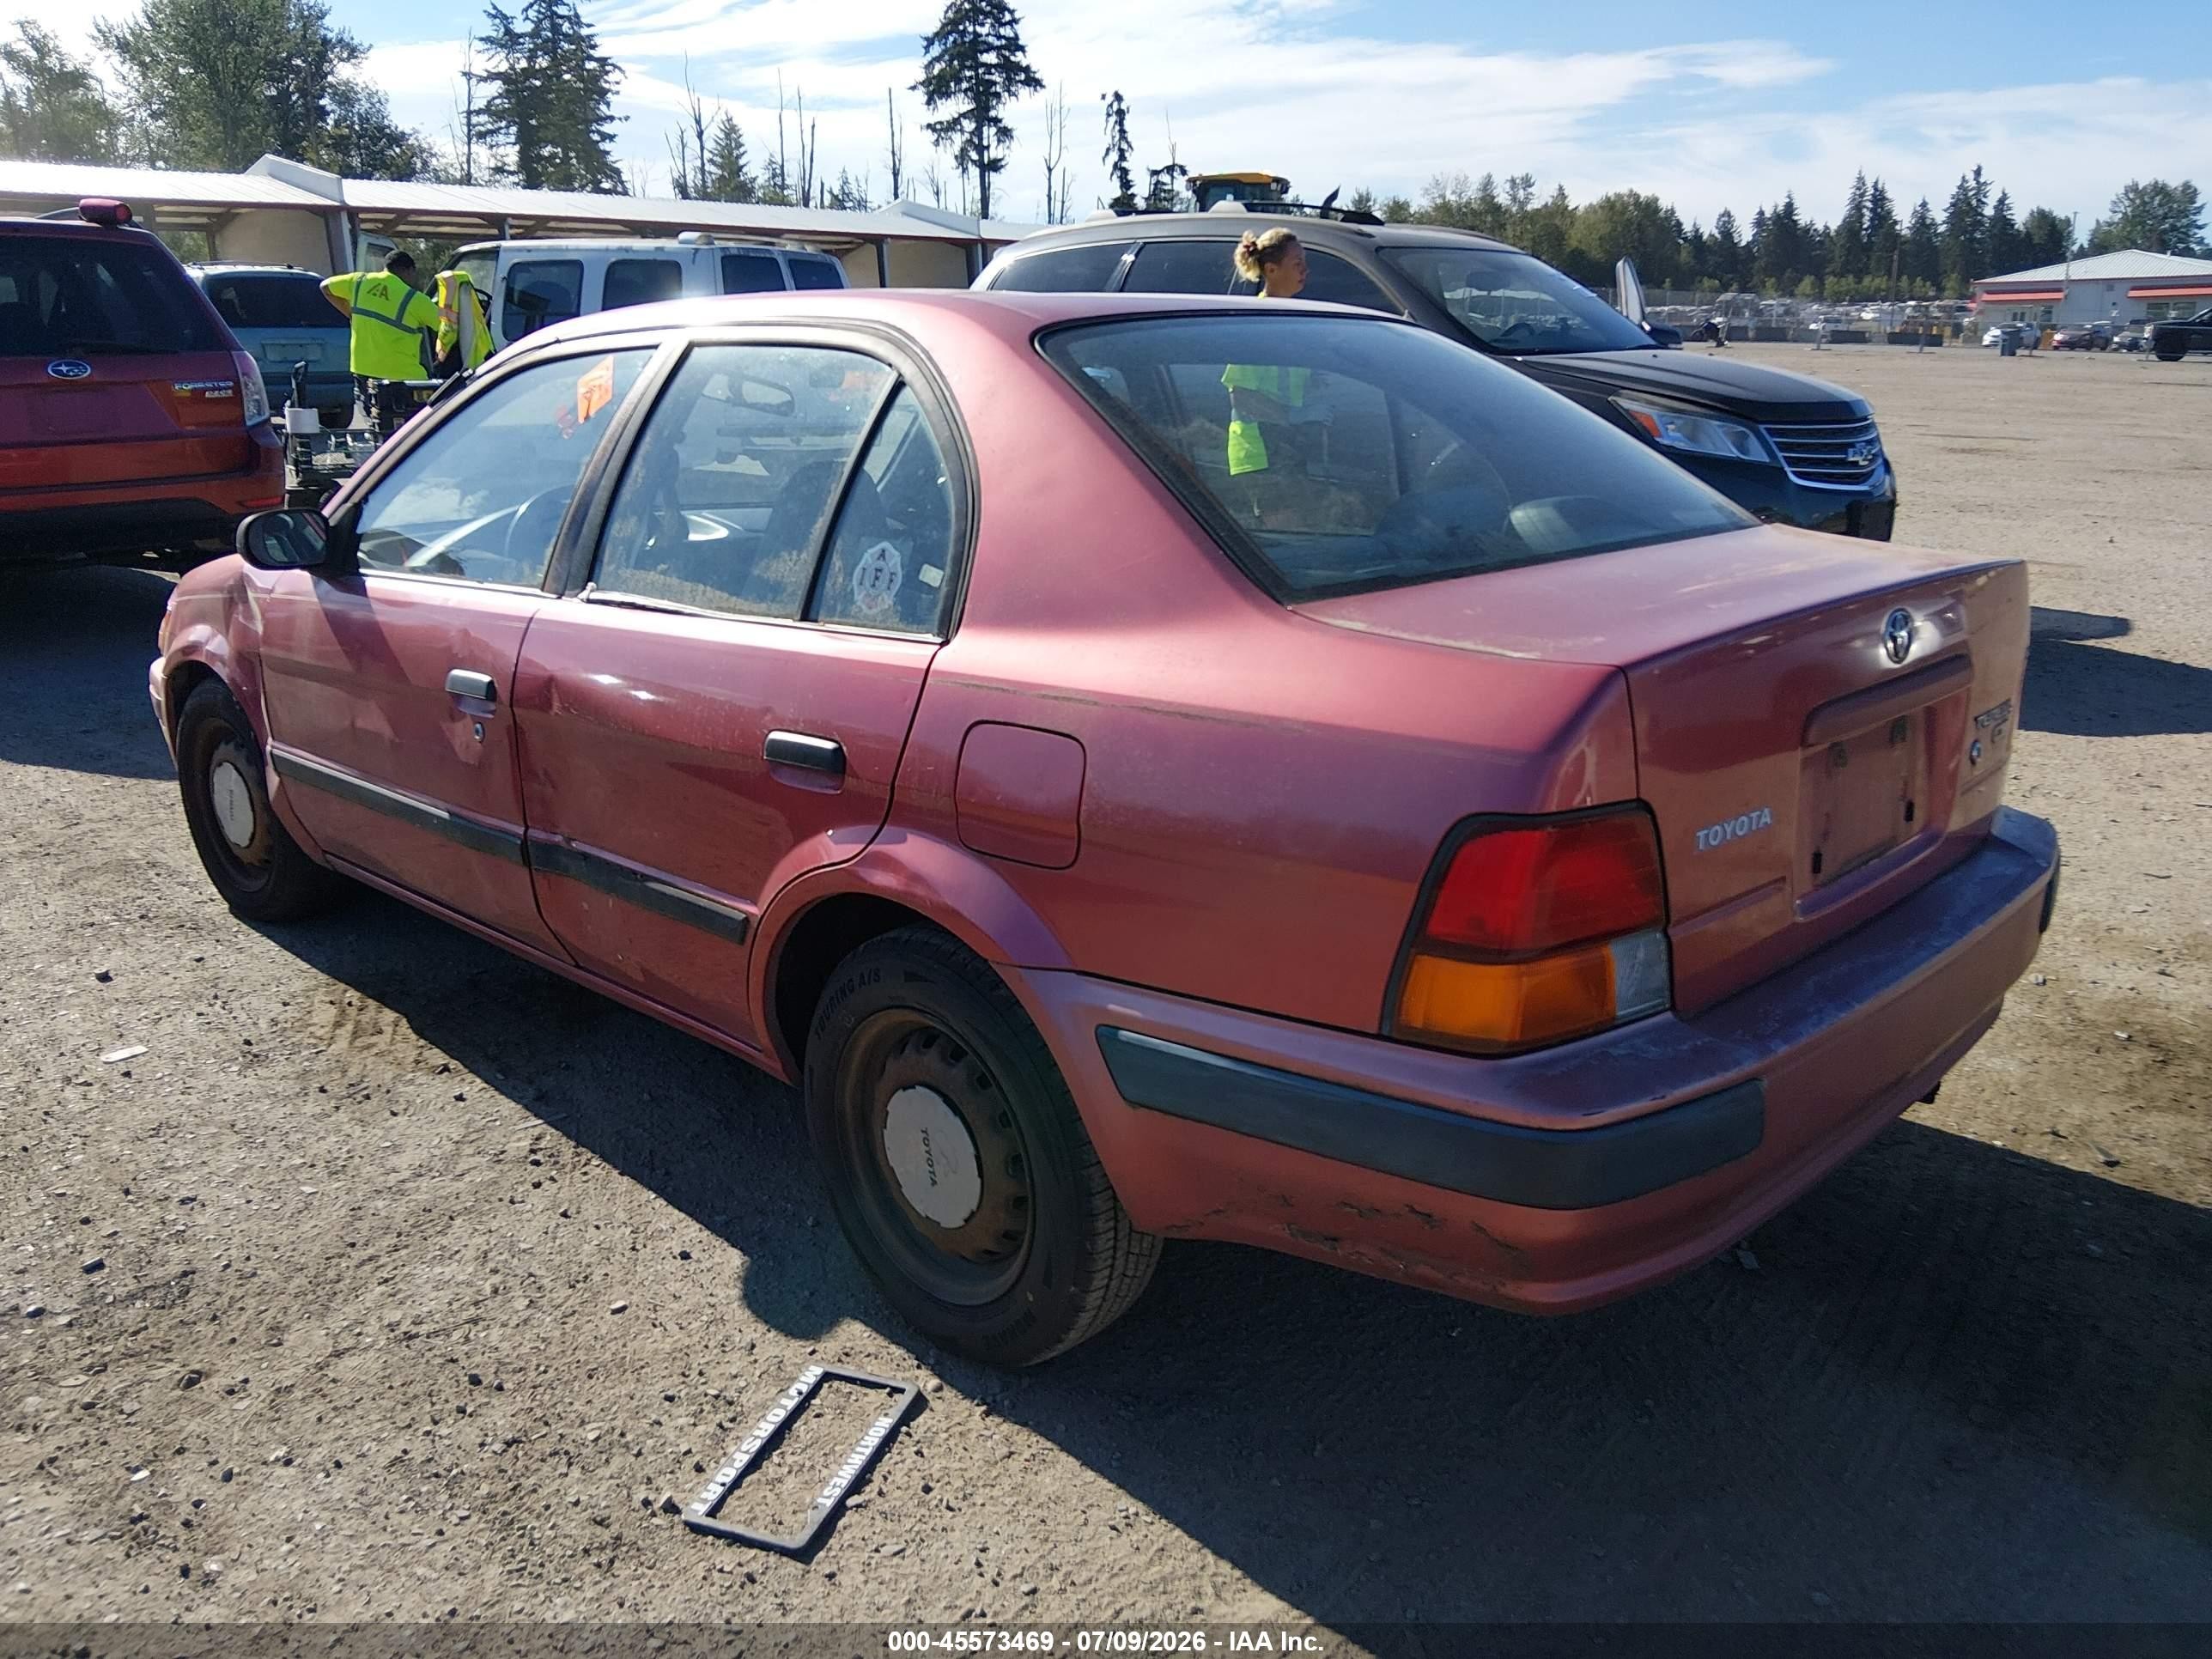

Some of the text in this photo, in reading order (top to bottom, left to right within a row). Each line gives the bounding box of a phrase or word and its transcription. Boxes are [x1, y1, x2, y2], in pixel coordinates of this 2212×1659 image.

[1695, 806, 1773, 851] TOYOTA
[920, 1127, 939, 1188] TOYOTA
[690, 1365, 824, 1516] MOTORSPORT
[817, 1417, 894, 1508] NORTHWEST
